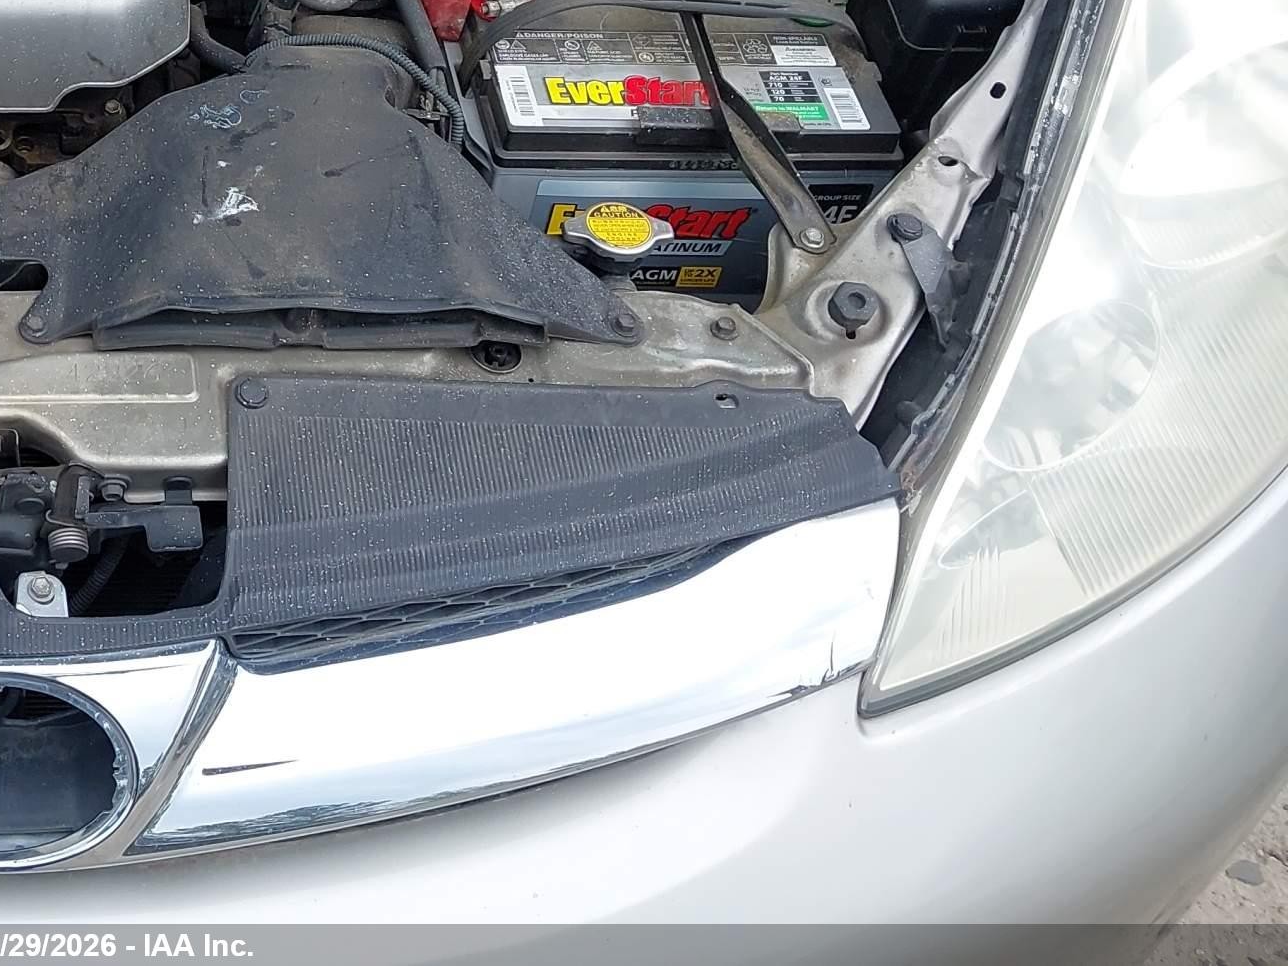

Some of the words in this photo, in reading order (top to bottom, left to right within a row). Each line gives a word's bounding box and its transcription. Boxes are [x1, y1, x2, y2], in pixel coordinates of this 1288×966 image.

[824, 205, 858, 224] 4F
[653, 242, 722, 252] ATINUM
[631, 269, 678, 280] AGM
[695, 268, 718, 278] 2X
